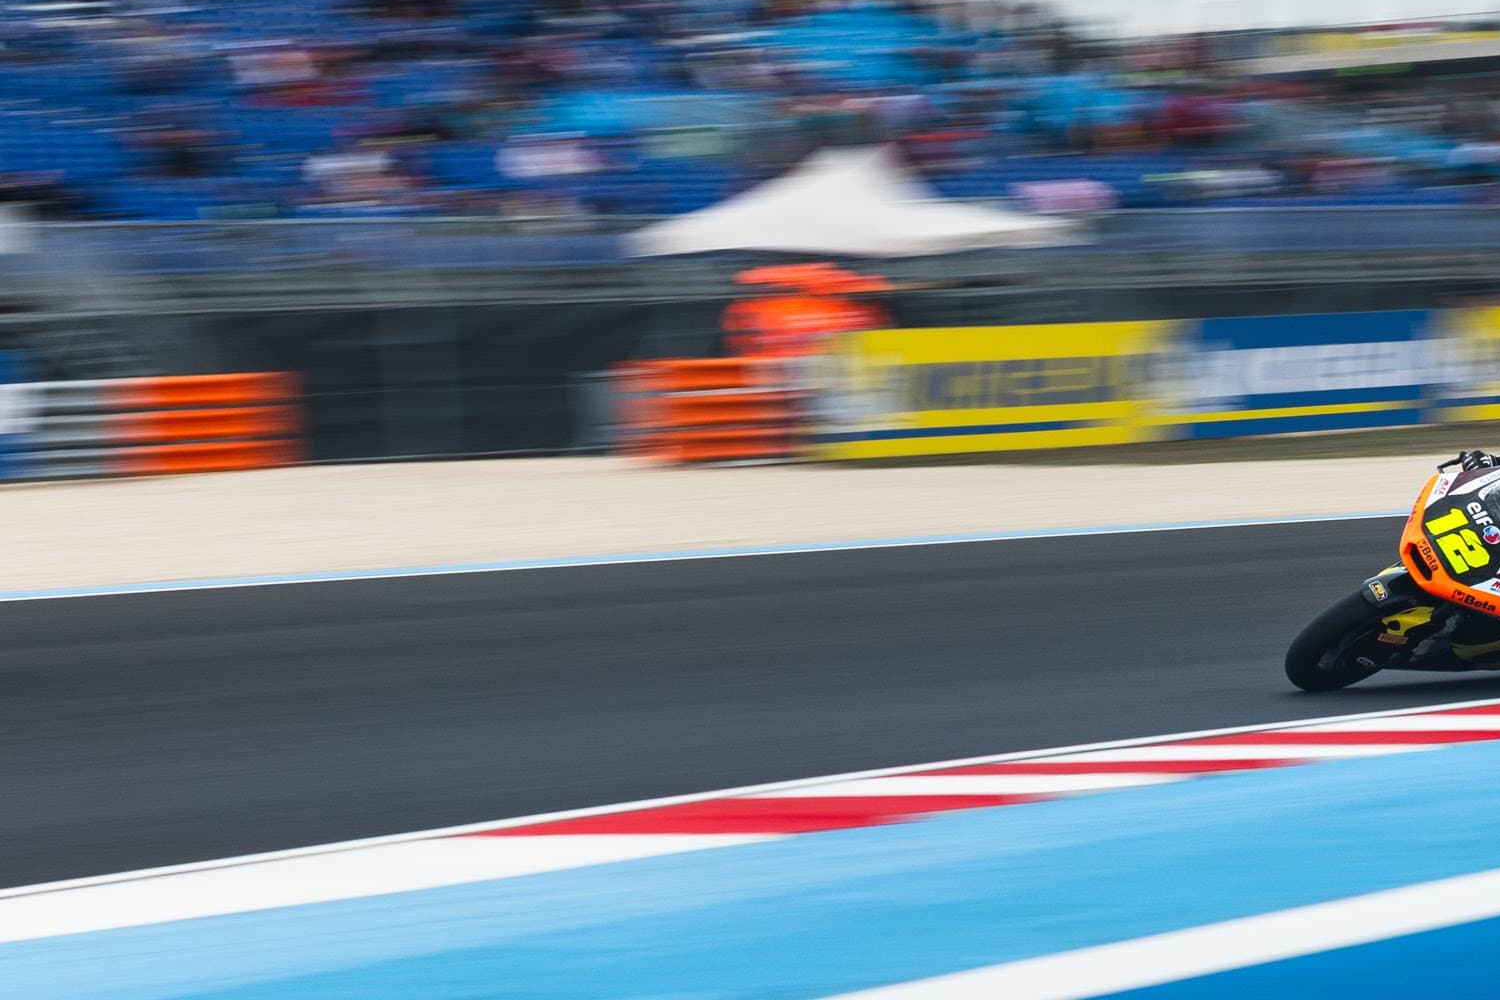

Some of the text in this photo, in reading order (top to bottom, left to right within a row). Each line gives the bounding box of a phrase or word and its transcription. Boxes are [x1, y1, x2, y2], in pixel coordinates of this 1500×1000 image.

[1466, 501, 1494, 526] elf
[1425, 507, 1490, 574] 12
[1422, 546, 1439, 571] Beta
[1464, 594, 1497, 612] Beta
